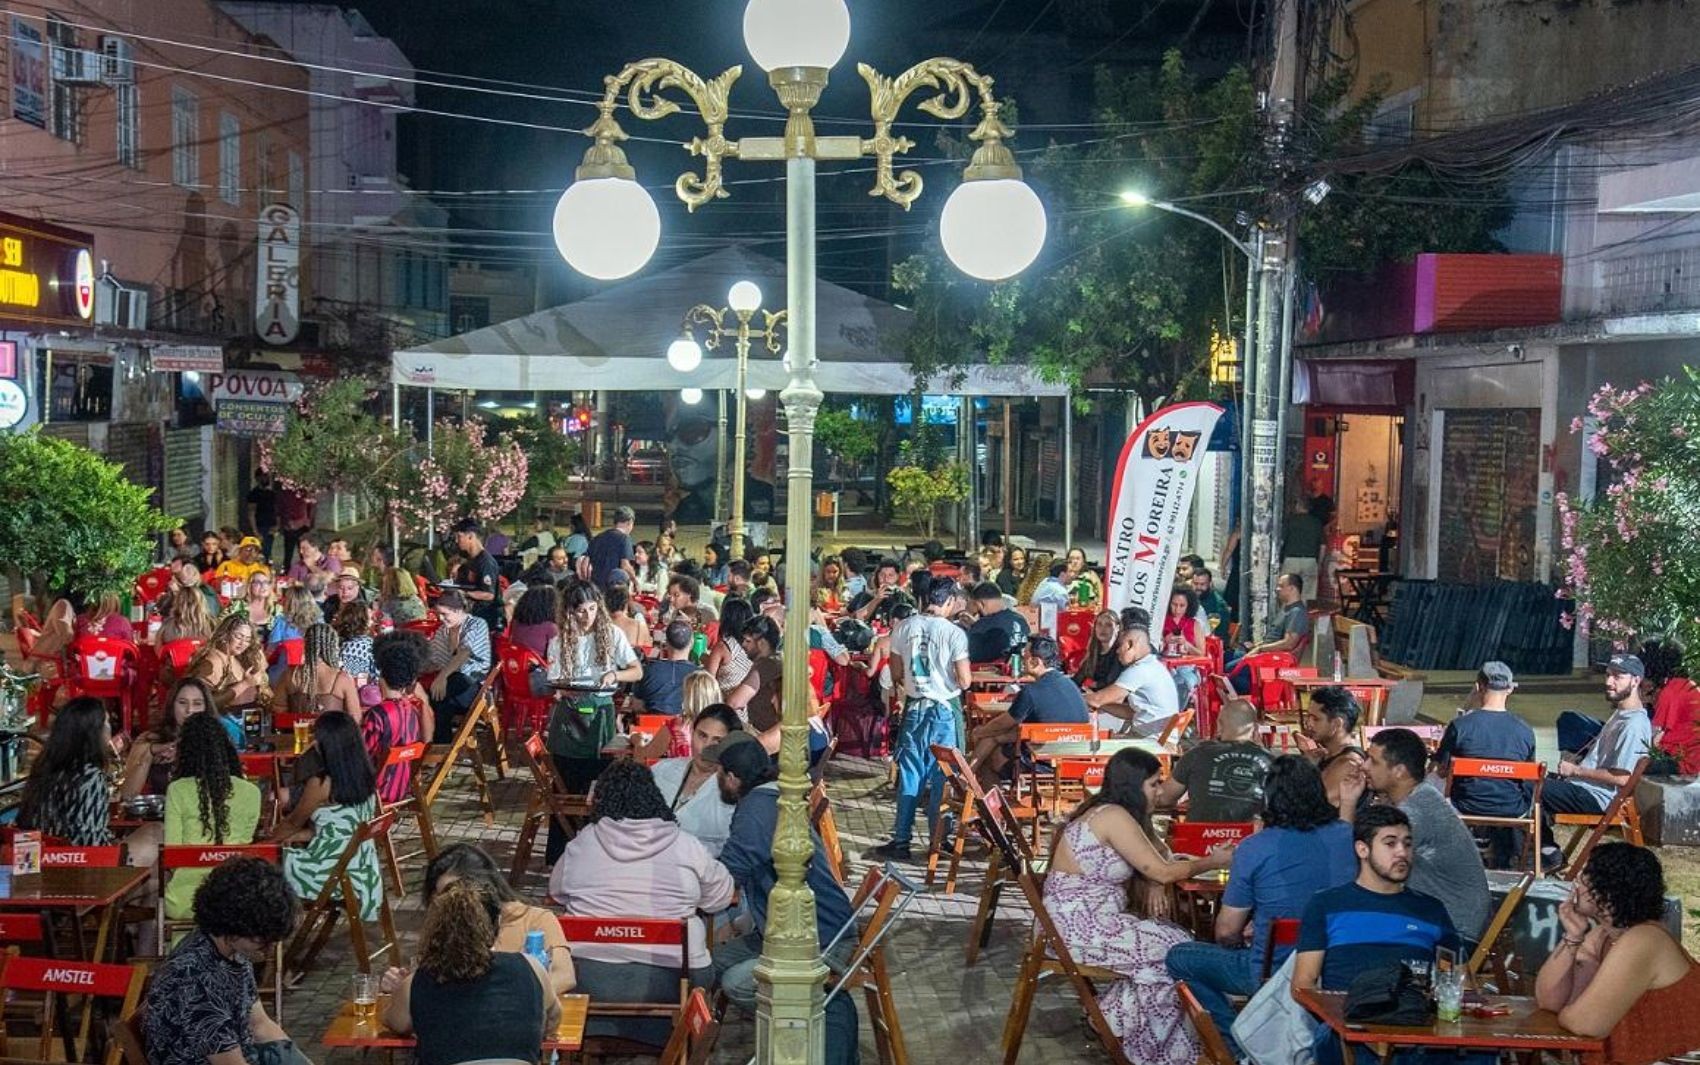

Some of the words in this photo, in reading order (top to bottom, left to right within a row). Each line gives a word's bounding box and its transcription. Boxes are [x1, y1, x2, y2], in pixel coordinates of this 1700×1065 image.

[264, 208, 290, 338] GALERIA
[1134, 466, 1174, 567] MOREIRA
[1109, 517, 1136, 587] TEATRO
[1479, 763, 1514, 774] AMSTEL
[1202, 828, 1242, 838] AMSTEL
[42, 852, 88, 863] AMSTEL
[595, 926, 646, 938] AMSTEL
[43, 968, 96, 985] AMSTEL
